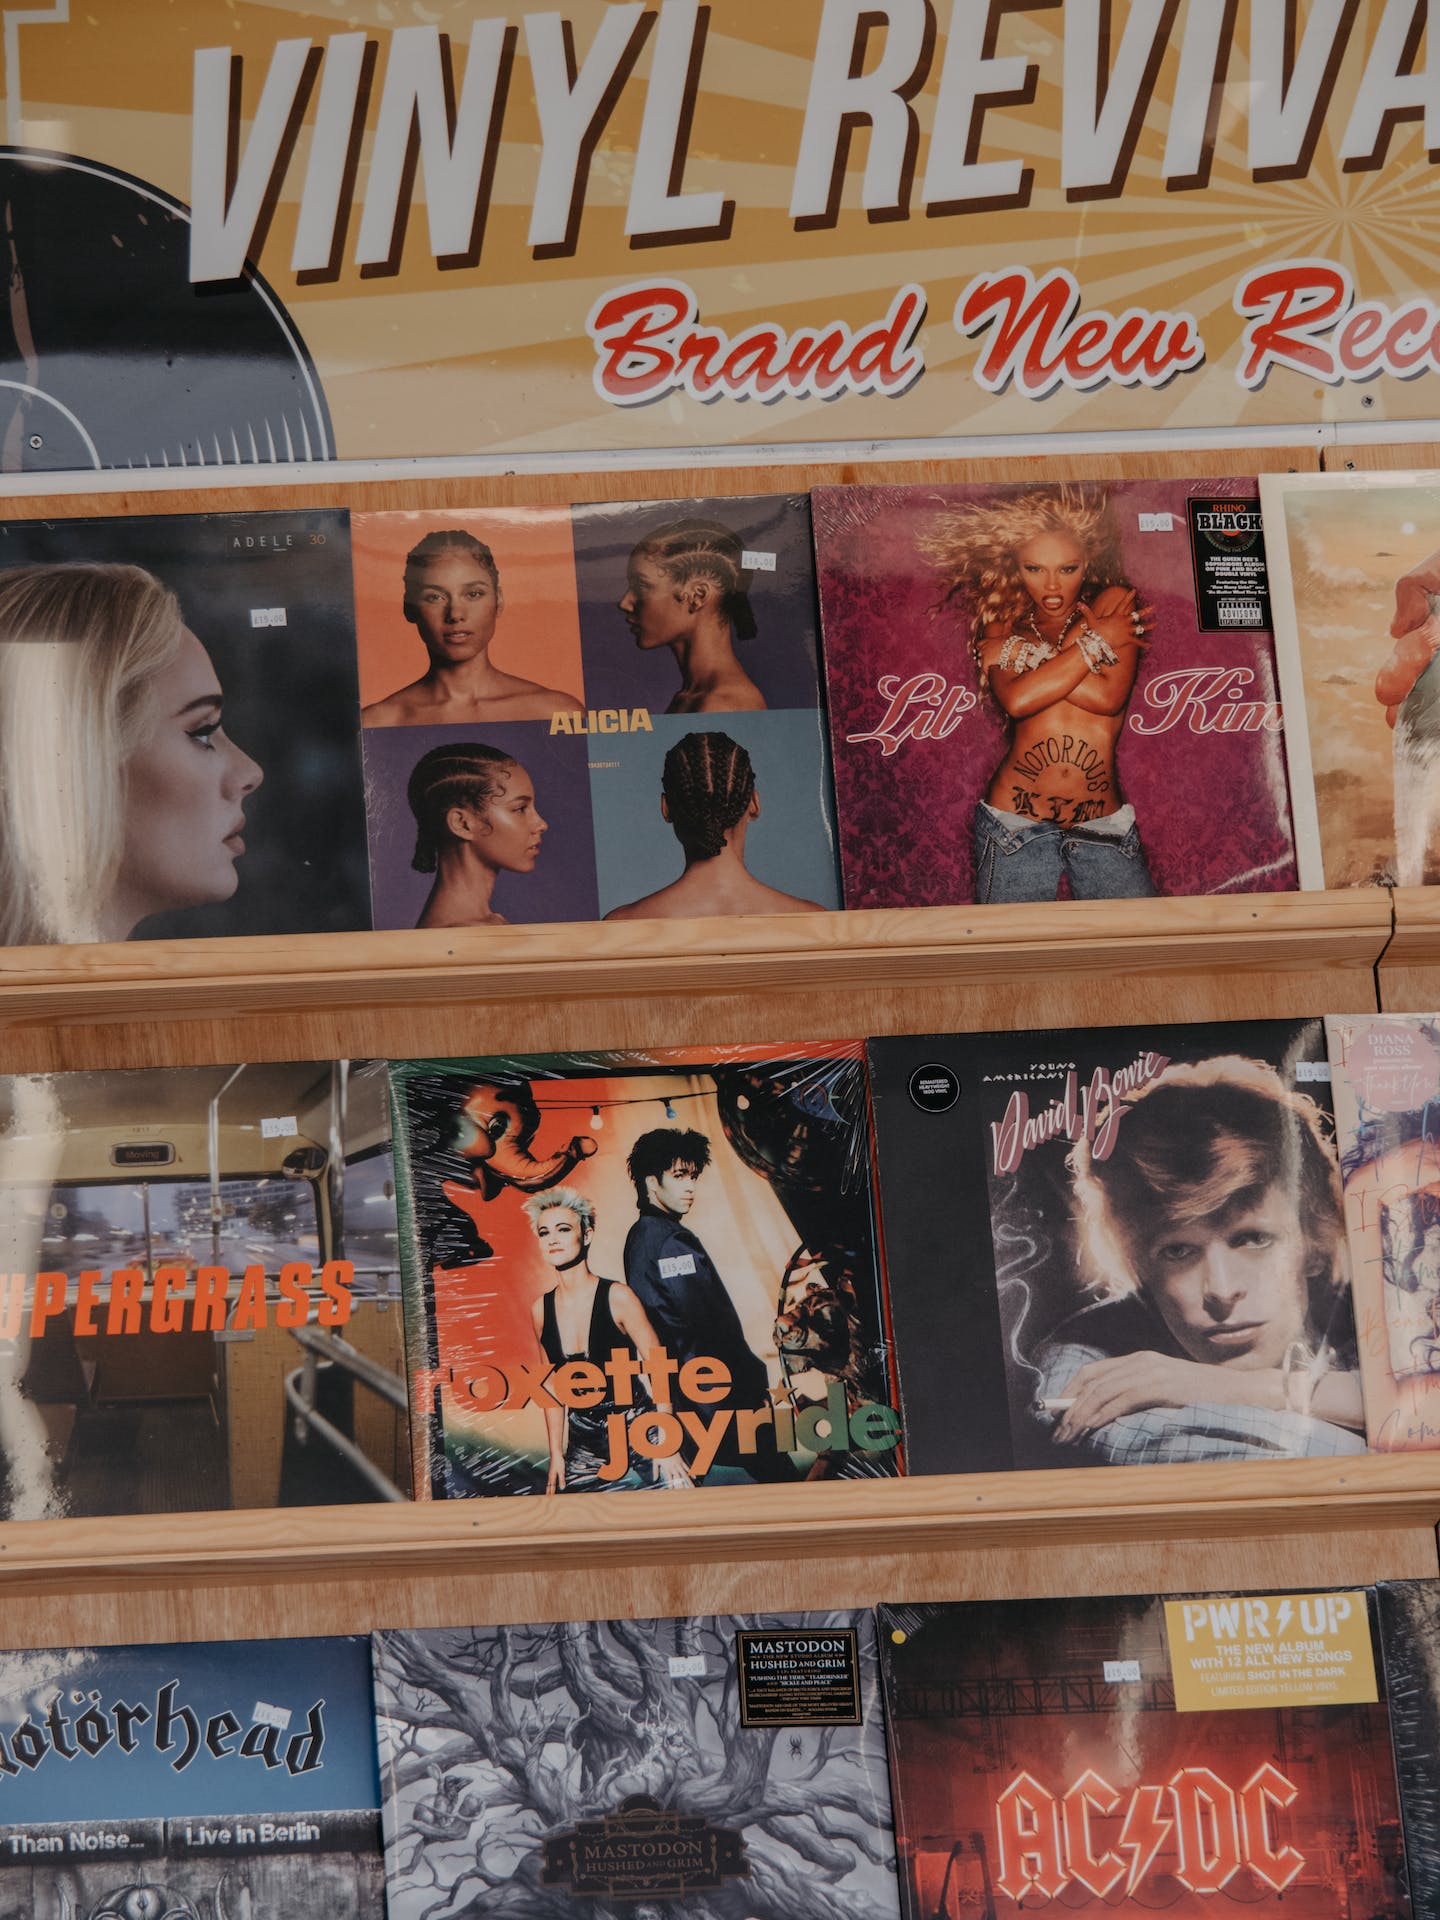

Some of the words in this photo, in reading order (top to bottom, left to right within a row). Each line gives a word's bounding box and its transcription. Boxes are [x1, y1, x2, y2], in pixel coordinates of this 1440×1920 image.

[190, 0, 728, 288] VINYL
[587, 279, 925, 403] Brand
[954, 266, 1204, 398] New
[1233, 258, 1440, 388] Rec
[1213, 504, 1246, 512] RHINO
[1197, 512, 1263, 531] BLACK
[233, 535, 293, 549] ADELE
[309, 534, 326, 545] 30
[1221, 610, 1259, 618] ADVISORY
[847, 673, 976, 756] Lil'
[1129, 667, 1284, 734] Kim
[549, 708, 653, 735] ALICIA
[1013, 735, 1109, 793] NOTORIOUS
[1368, 1033, 1414, 1045] DIANA
[1373, 1045, 1411, 1056] ROSS
[1030, 1062, 1076, 1070] YOUNG
[982, 1071, 1064, 1082] AMERICANS
[990, 1070, 1084, 1177] David
[1080, 1051, 1168, 1161] Bowie
[414, 1346, 732, 1414] roxette
[597, 1381, 902, 1481] joyride
[1183, 1599, 1270, 1642] PWR
[1300, 1597, 1351, 1635] UP
[750, 1640, 846, 1654] MASTODON
[1216, 1644, 1241, 1656] THE
[1245, 1642, 1275, 1655] NEW
[1279, 1640, 1325, 1653] ALBUM
[750, 1660, 798, 1669] HUSHED
[817, 1659, 846, 1668] GRIM
[1190, 1656, 1223, 1669] WITH
[1227, 1656, 1241, 1667] 12
[1244, 1654, 1270, 1666] ALL
[1273, 1653, 1303, 1665] NEW
[1306, 1650, 1353, 1663] SONGS
[1200, 1672, 1245, 1683] FEATURING
[1247, 1669, 1276, 1680] SHOT
[1279, 1669, 1290, 1679] IN
[1292, 1668, 1313, 1678] THE
[1315, 1667, 1345, 1677] DARK
[1211, 1685, 1244, 1697] LIMITED
[1246, 1684, 1278, 1696] EDITION
[1279, 1682, 1313, 1694] YELLOW
[1315, 1681, 1338, 1692] VINYL
[0, 1678, 326, 1777] otörhead
[8, 1834, 64, 1855] Than
[69, 1830, 145, 1850] Noise...
[186, 1825, 232, 1846] Live
[236, 1824, 256, 1844] in
[260, 1821, 321, 1843] Berlin
[584, 1840, 703, 1860] MASTODON
[586, 1860, 645, 1873] HUSHED
[645, 1860, 666, 1868] AND
[667, 1858, 703, 1869] GRIM
